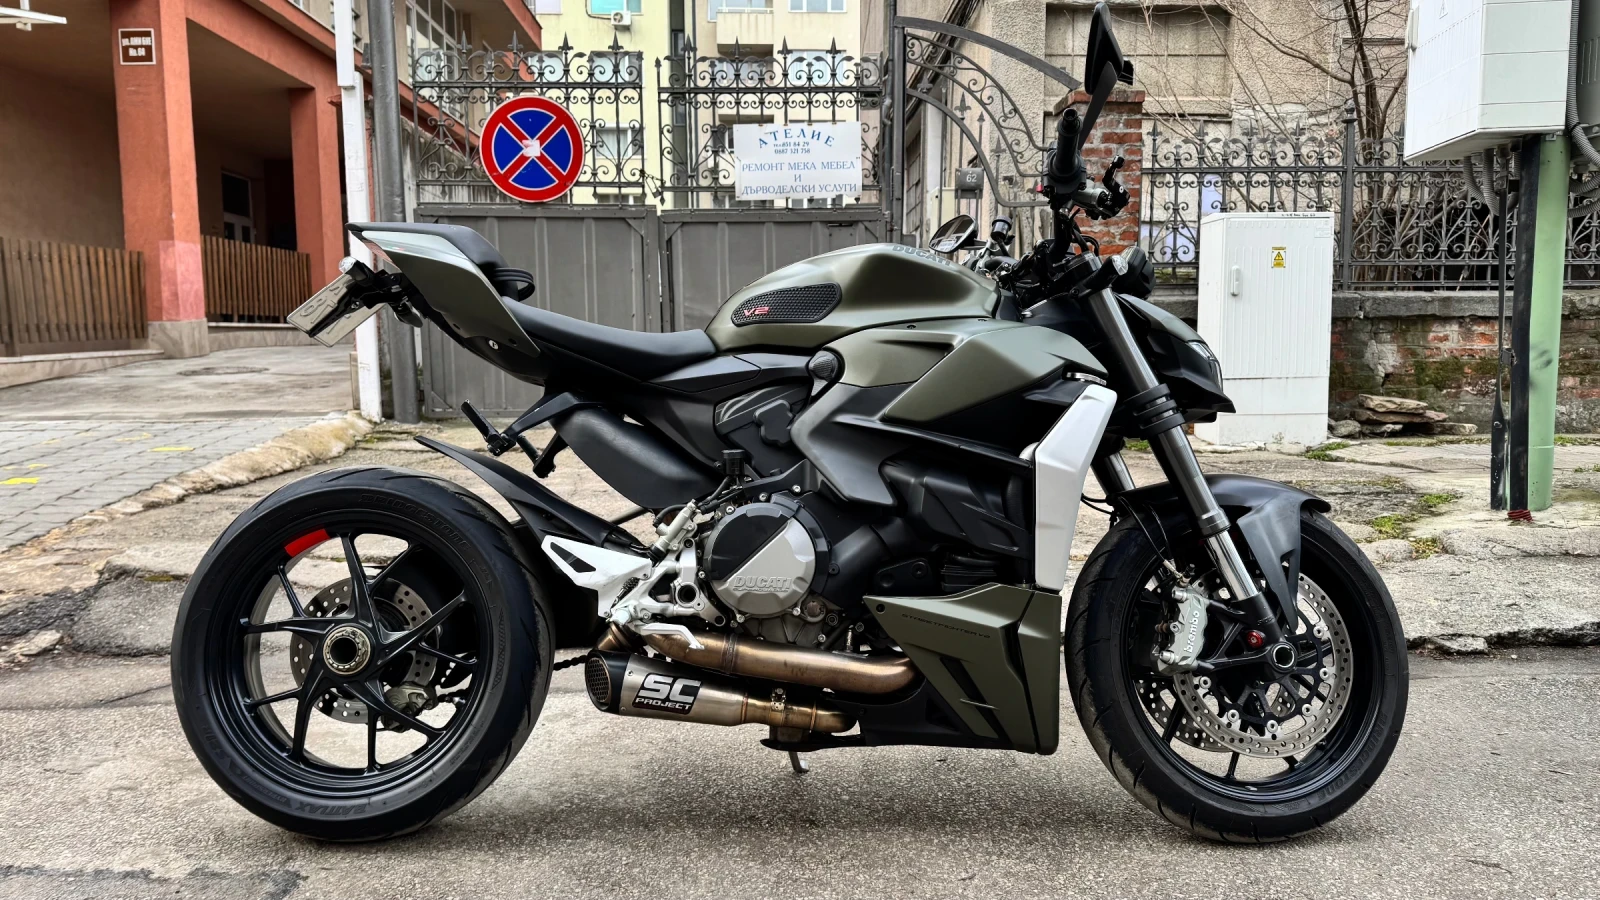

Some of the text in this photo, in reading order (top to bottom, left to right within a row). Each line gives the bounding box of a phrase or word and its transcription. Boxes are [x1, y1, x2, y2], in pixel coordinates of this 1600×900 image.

[758, 128, 835, 148] АТЕЛИЕ
[742, 161, 855, 171] РЕМОНТ МЕКА МЕБЕЛ
[794, 174, 802, 182] И
[966, 173, 977, 182] 62
[741, 183, 857, 196] ДЪРВОДЕЛСКИ УСЛУГИ
[892, 244, 952, 267] DUCATI
[744, 306, 770, 317] V2
[733, 575, 792, 589] DUCATI
[1183, 610, 1200, 653] brembo
[638, 674, 701, 703] SC
[635, 697, 691, 710] PROJECT
